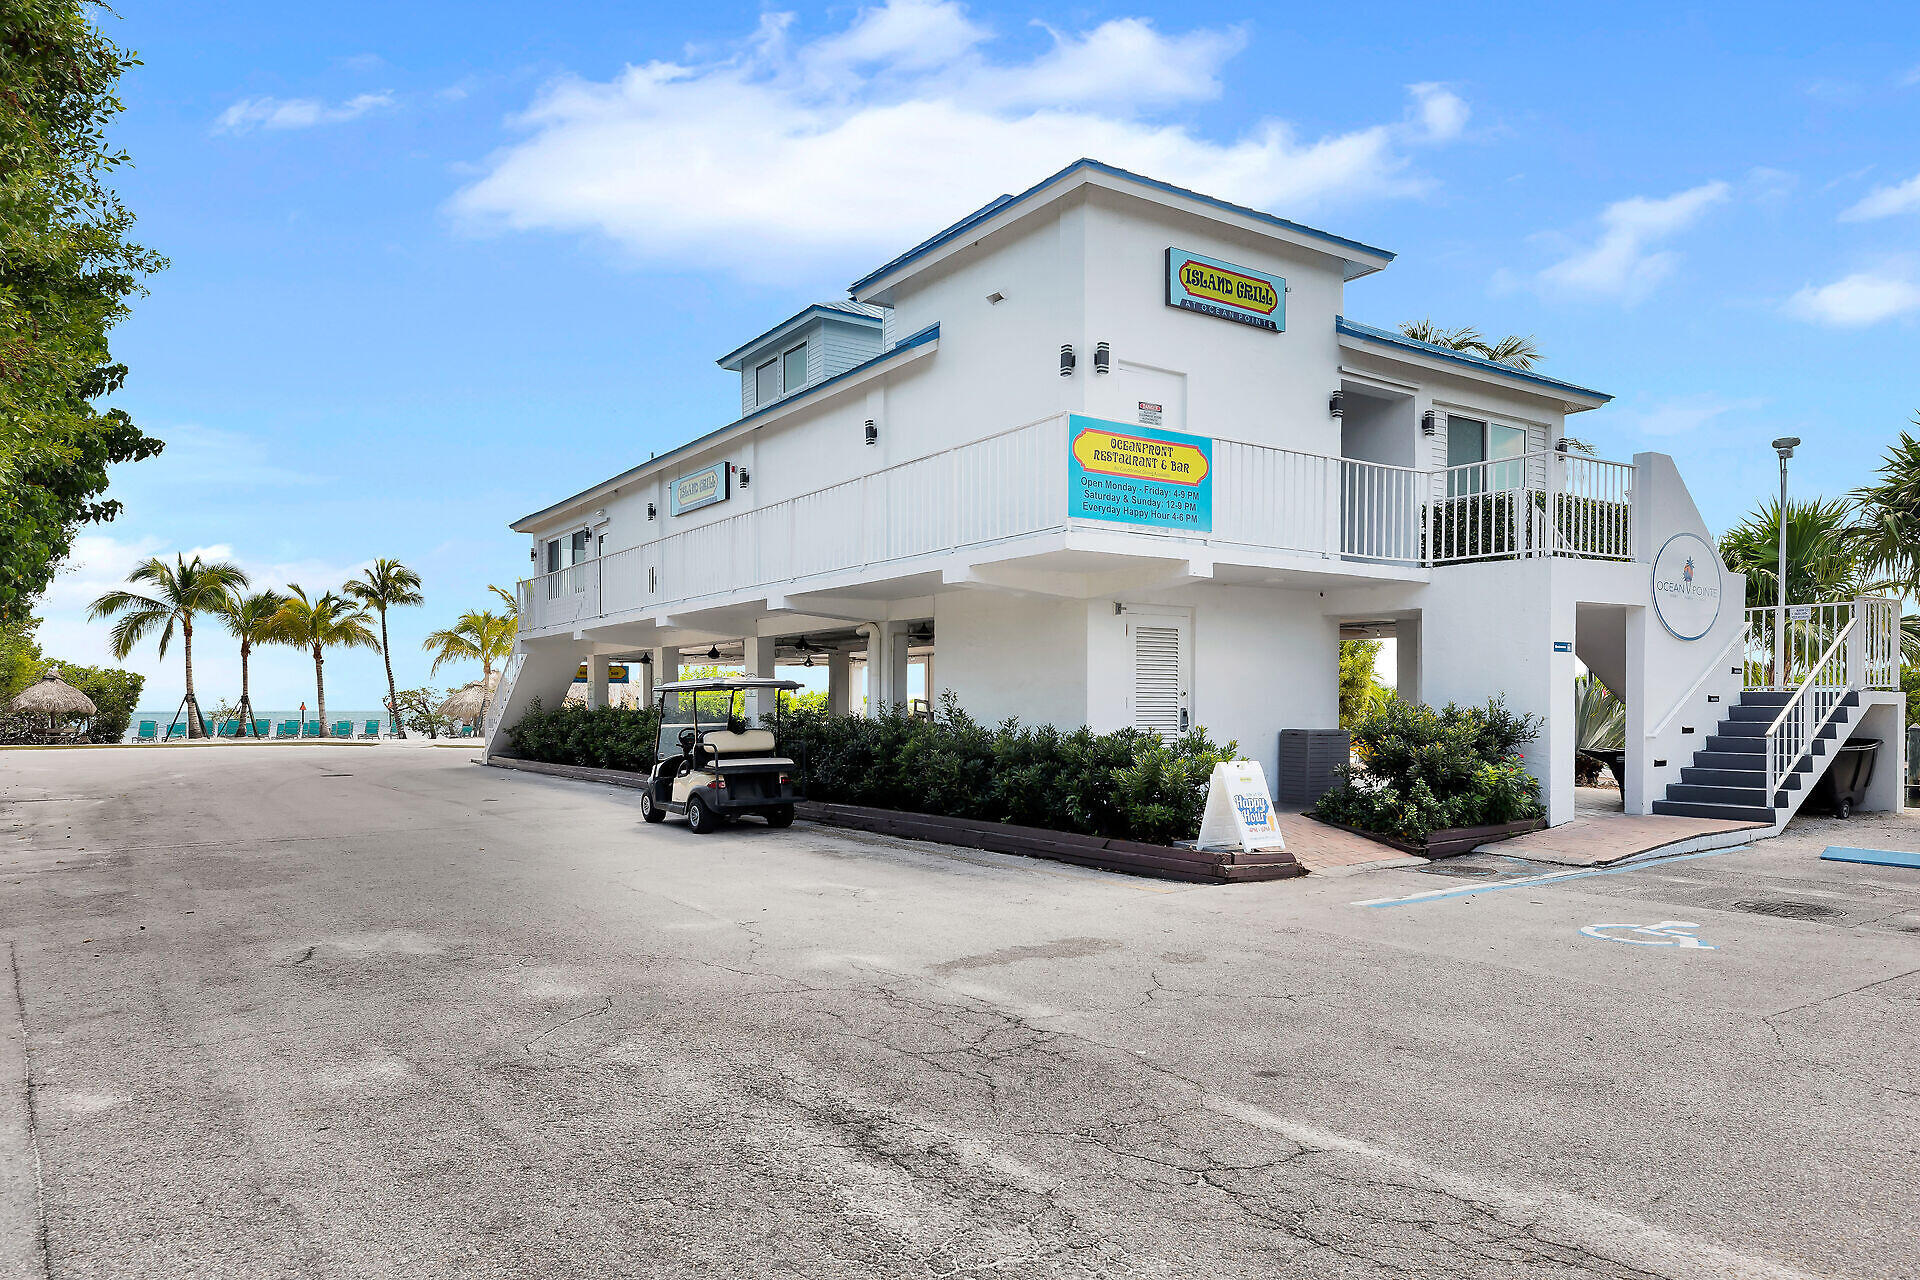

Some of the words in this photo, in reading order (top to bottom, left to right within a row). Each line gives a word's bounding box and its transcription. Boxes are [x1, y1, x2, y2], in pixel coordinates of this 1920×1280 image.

[1185, 268, 1233, 295] ISLAND
[1236, 281, 1273, 306] GRILL
[1185, 301, 1197, 309] AT
[1201, 304, 1234, 319] OCEAN
[1238, 314, 1273, 328] POINTE
[1110, 438, 1174, 457] OCEANFRONT
[1094, 449, 1158, 469] RESTAURANT
[1161, 460, 1167, 470] &
[1081, 477, 1102, 488] Open
[1105, 480, 1137, 493] Monday
[1144, 485, 1171, 499] Friday:
[1173, 489, 1185, 499] 4-9
[1187, 491, 1200, 501] PM
[1084, 490, 1120, 504] Saturday
[1123, 495, 1129, 503] &
[1131, 496, 1164, 508] Sunday:
[1167, 500, 1182, 510] 12-9
[1184, 502, 1197, 512] PM
[1083, 502, 1120, 516] Everyday
[1123, 507, 1149, 519] Happy
[1151, 509, 1169, 520] Hour
[1171, 512, 1184, 521] 4-6
[1185, 514, 1198, 523] PM
[1656, 580, 1685, 594] OCEAN
[1692, 585, 1718, 598] POINTE
[1234, 794, 1266, 813] Happy
[1242, 809, 1266, 823] Hour
